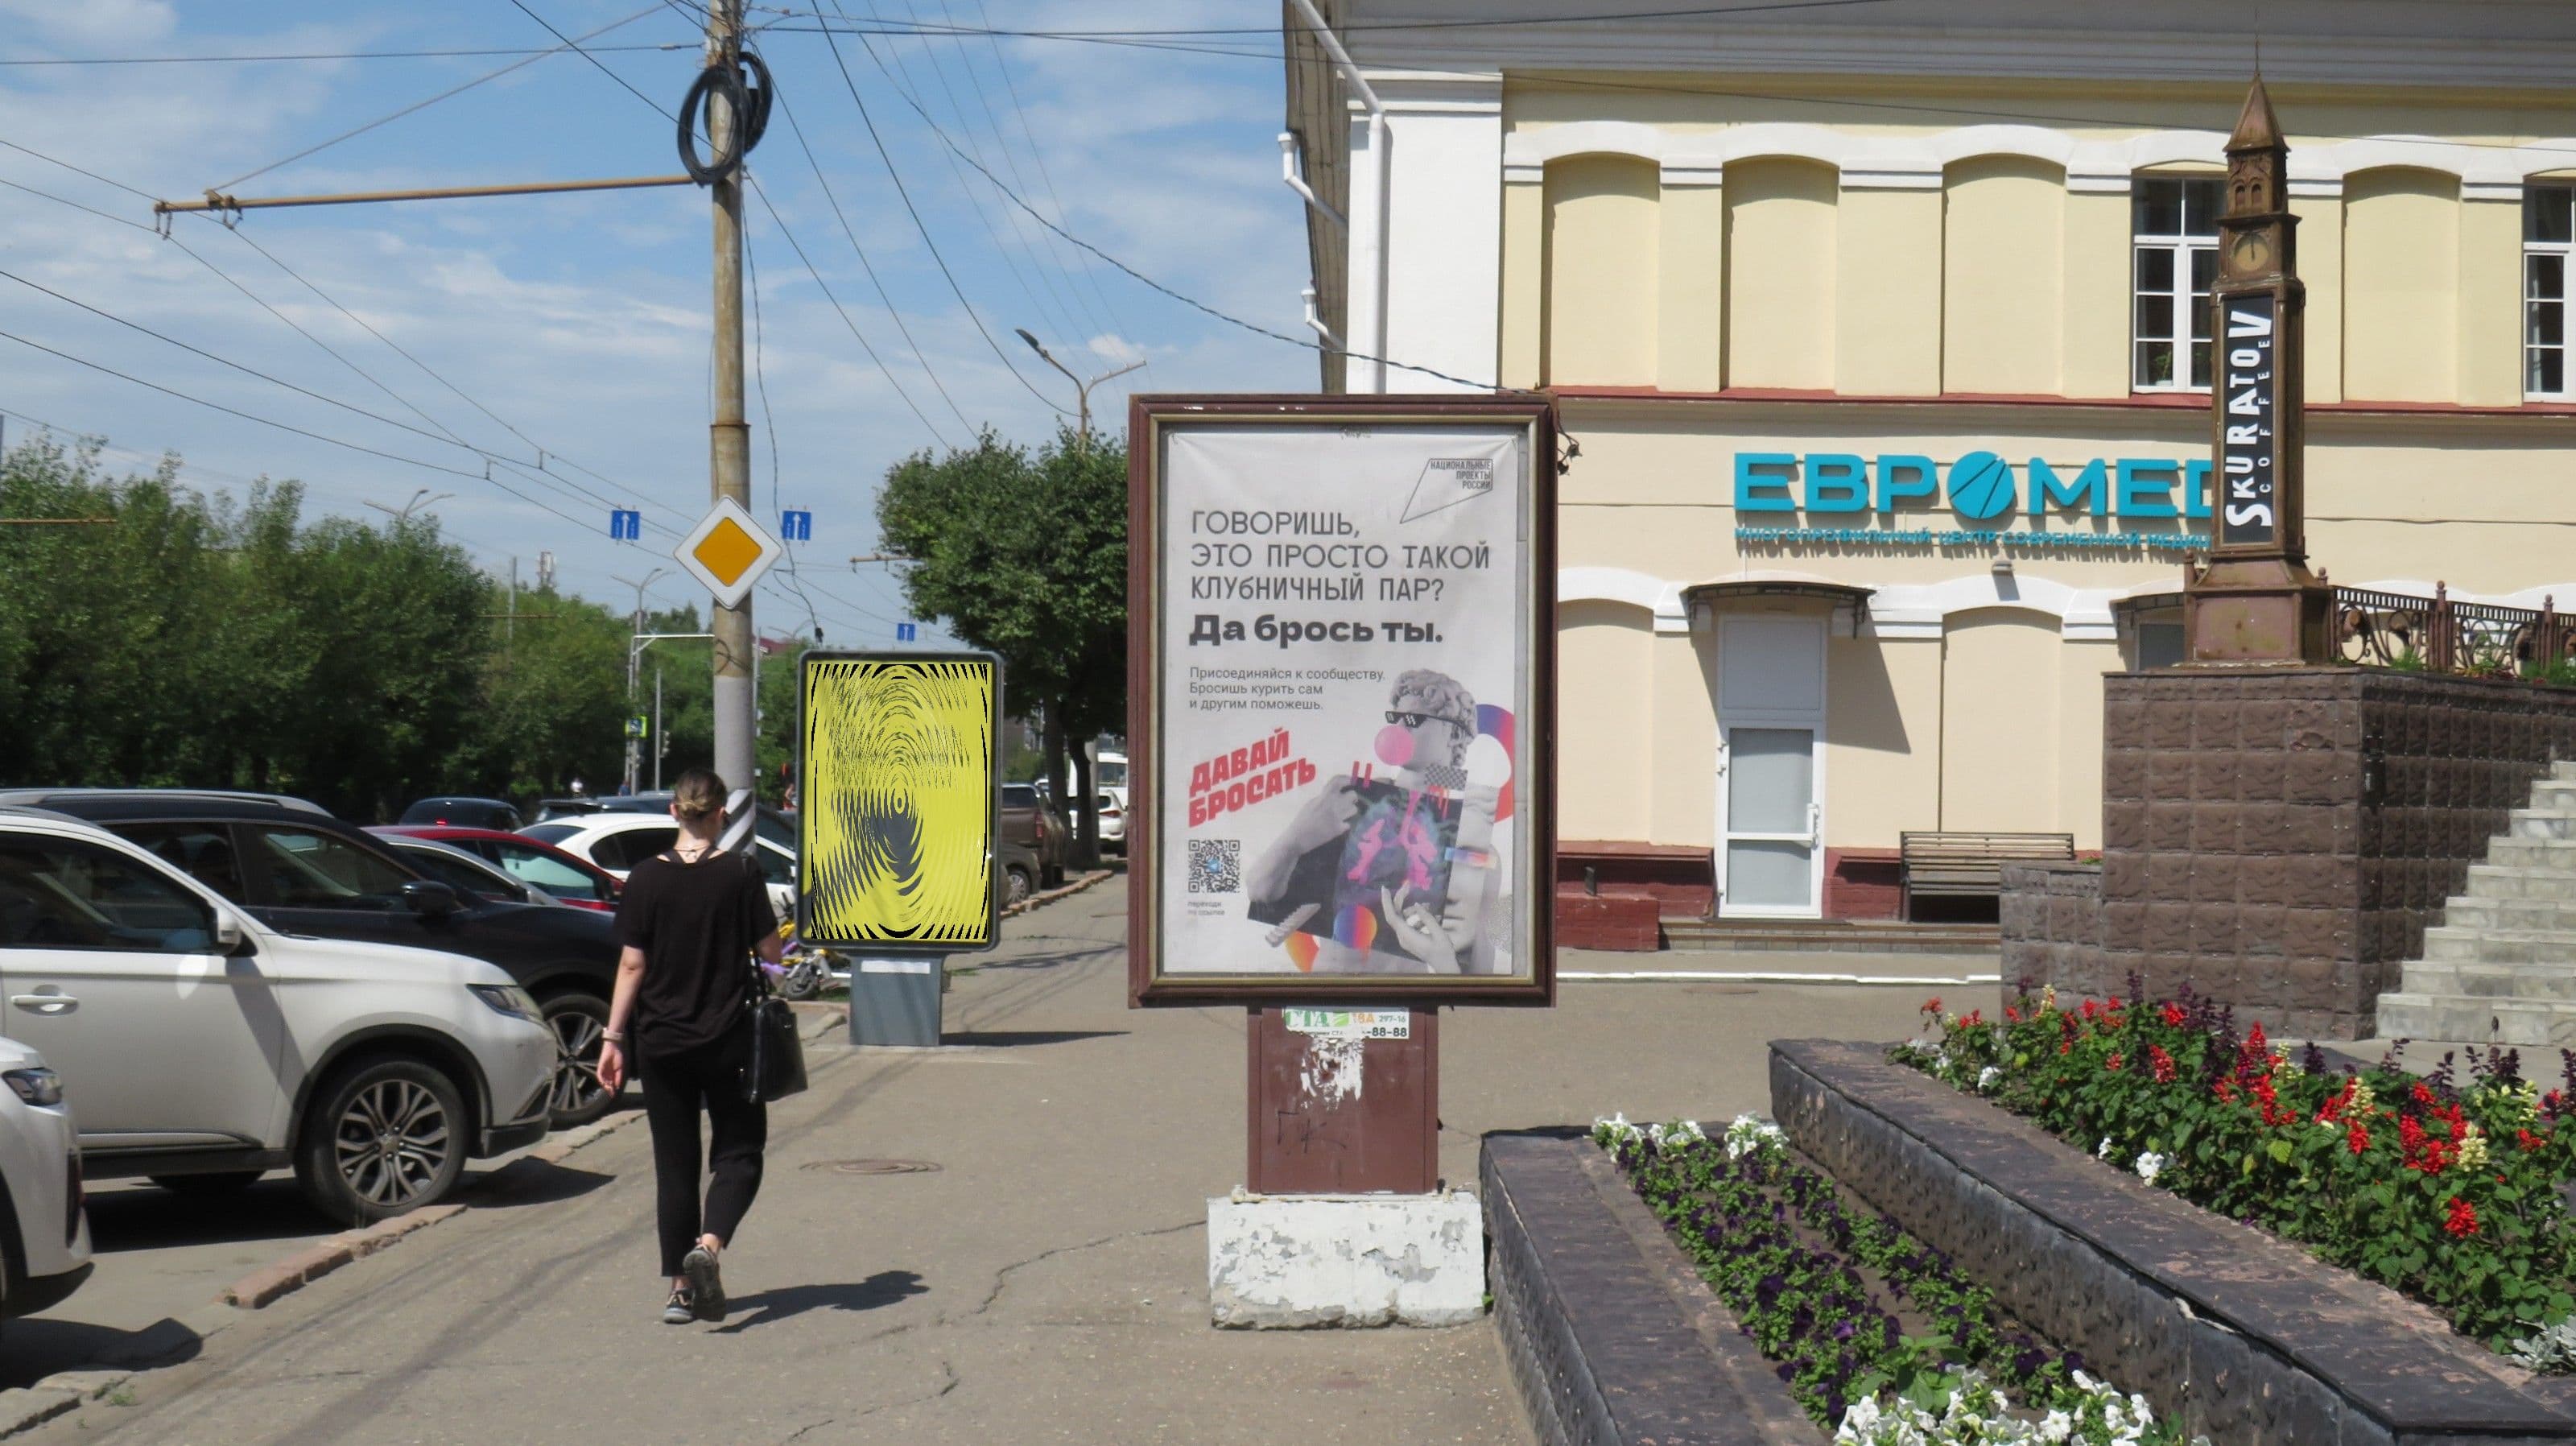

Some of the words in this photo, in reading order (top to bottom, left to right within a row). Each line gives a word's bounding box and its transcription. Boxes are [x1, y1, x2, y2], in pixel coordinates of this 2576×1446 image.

[2257, 339, 2271, 494] COFFEE
[1430, 461, 1491, 470] НАЦИОНАЛЬНЫЕ
[1455, 470, 1491, 480] ПРОЕКТЫ
[1462, 480, 1491, 490] РОССИИ
[1191, 510, 1360, 538] ГОВОРИШЬ,
[1735, 527, 1932, 543] МНОГОПРОФИЛЬНЫЙ
[1939, 529, 1996, 545] ЦЕНТР
[2001, 530, 2140, 547] СОВРЕМЕННОЙ
[2147, 533, 2211, 550] МЕДИЦ
[1191, 543, 1253, 568] ЭТО
[1267, 544, 1389, 569] ПРОСТО
[1402, 540, 1489, 569] ТАКОЙ
[1380, 578, 1444, 601] ПАР?
[1189, 614, 1246, 646] Да
[1254, 614, 1374, 649] брось
[1381, 621, 1443, 642] ты.
[1190, 667, 1292, 682] Присоединяйся
[1296, 670, 1303, 680] к
[1190, 682, 1248, 696] Бросишь
[1251, 684, 1294, 697] курить
[1298, 685, 1323, 695] сам
[1189, 700, 1197, 709] и
[1200, 700, 1247, 713] другим
[1251, 699, 1323, 710] поможешь.
[1189, 726, 1290, 799] ДАВАЙ
[1188, 758, 1317, 828] БРОСАТЬ
